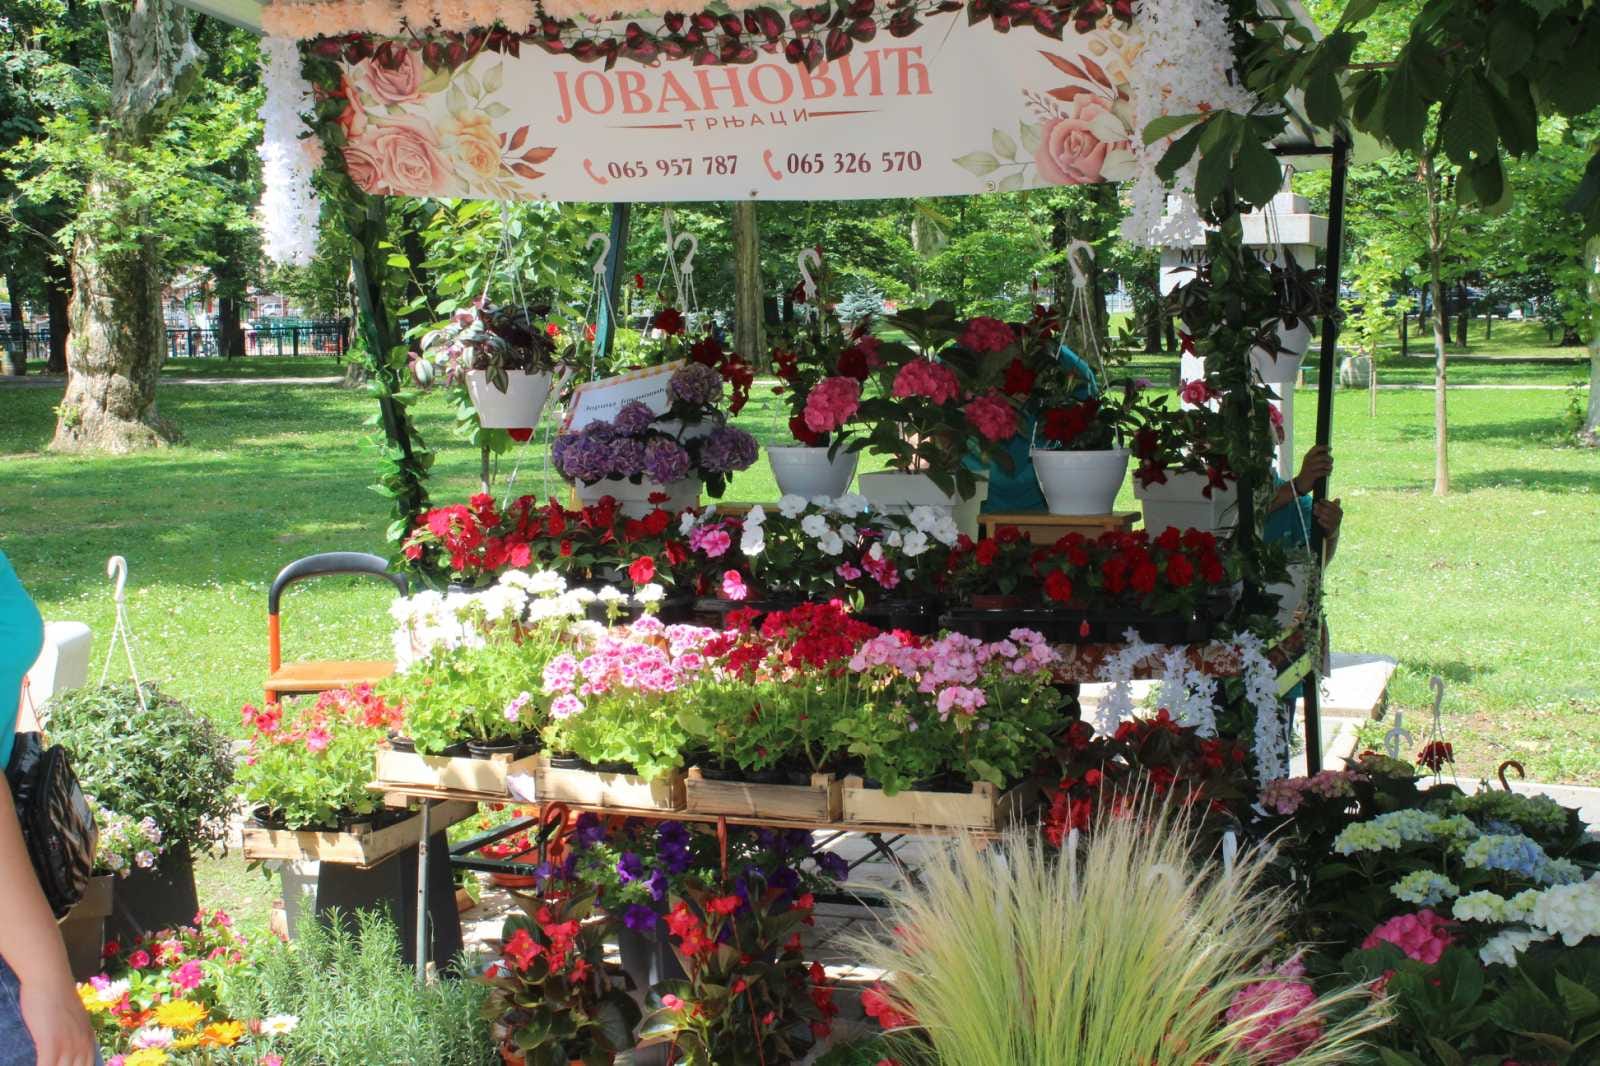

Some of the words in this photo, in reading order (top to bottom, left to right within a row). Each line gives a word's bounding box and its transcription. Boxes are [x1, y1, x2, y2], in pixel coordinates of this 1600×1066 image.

[553, 46, 933, 124] ЈОВАНОВИЋ
[683, 108, 808, 132] ТРЊАЦИ
[608, 160, 648, 179] 065
[656, 157, 693, 177] 957
[702, 155, 738, 176] 787
[787, 153, 825, 174] 065
[833, 152, 871, 174] 326
[881, 150, 922, 172] 570
